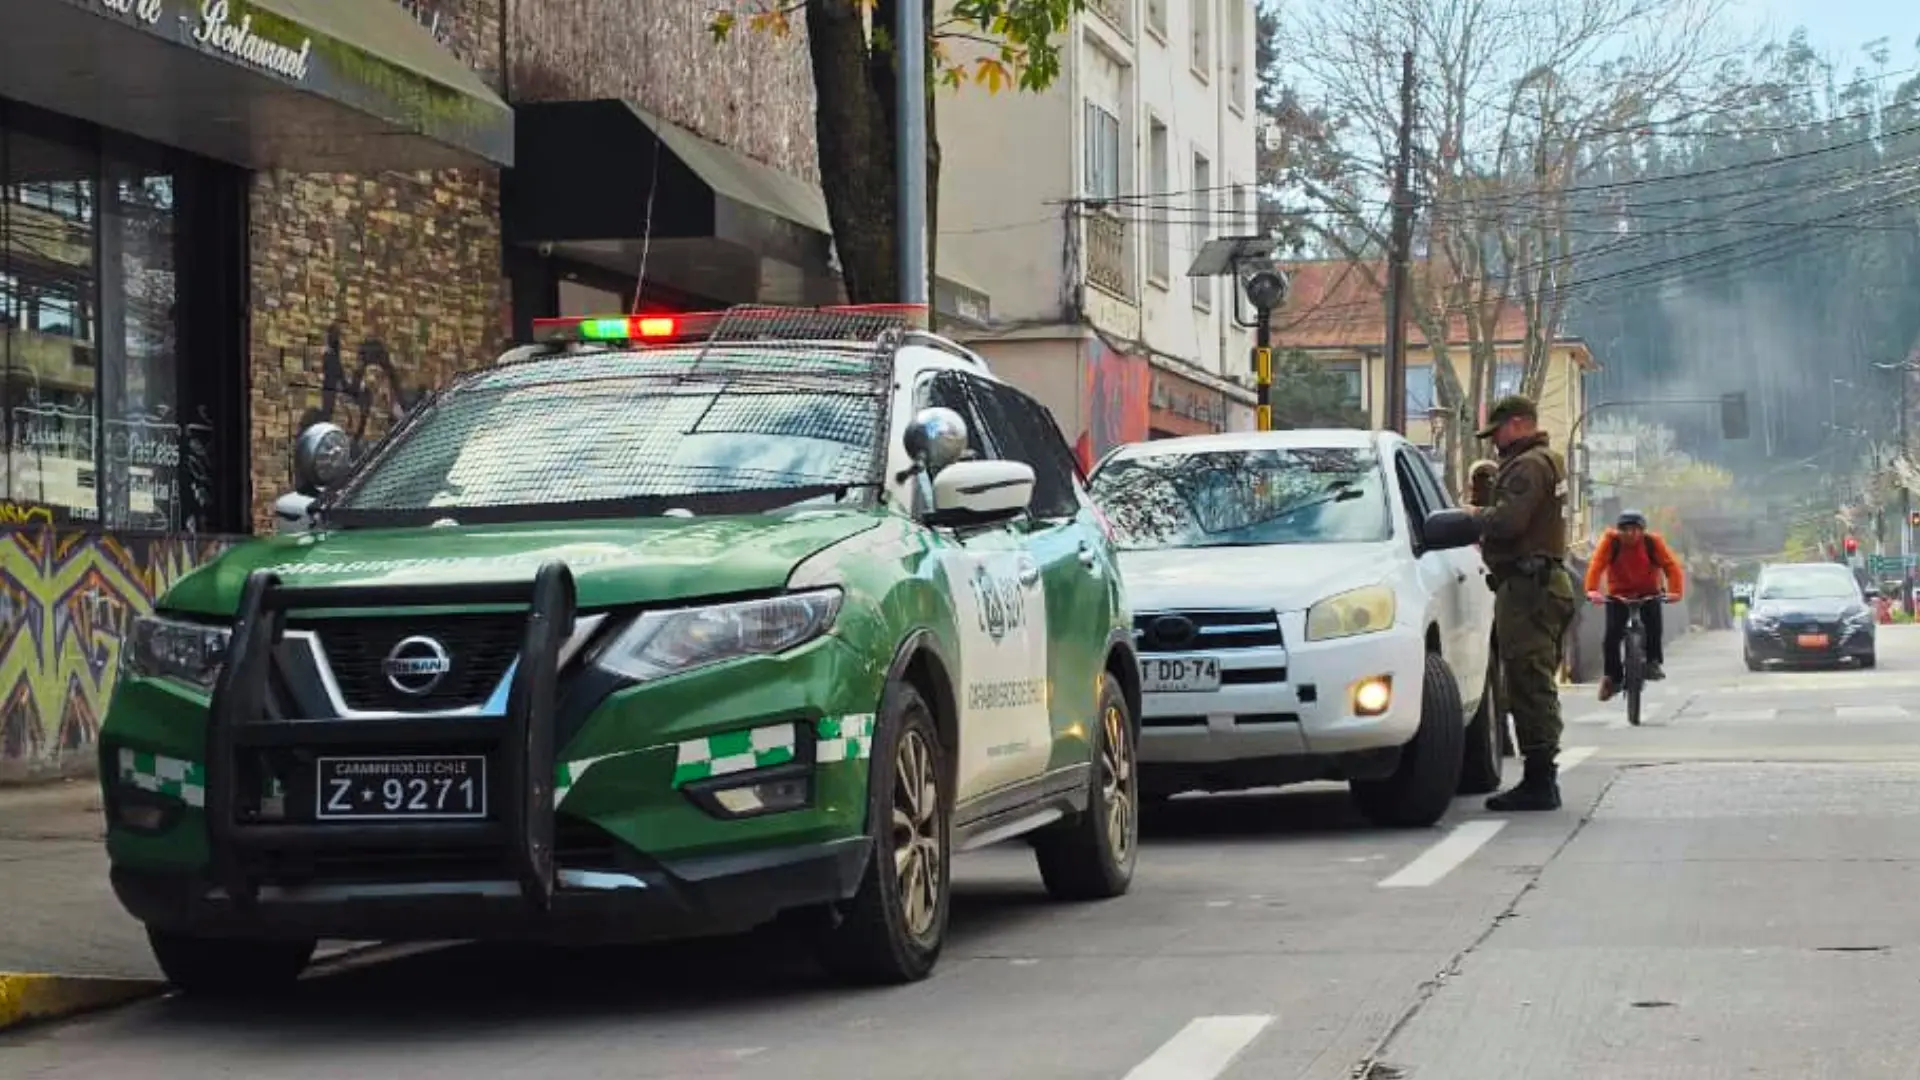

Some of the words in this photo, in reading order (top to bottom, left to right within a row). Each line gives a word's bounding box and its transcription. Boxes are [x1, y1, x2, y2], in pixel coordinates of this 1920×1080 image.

[417, 762, 432, 774] DE
[328, 778, 353, 811] Z
[382, 776, 474, 811] 9271
